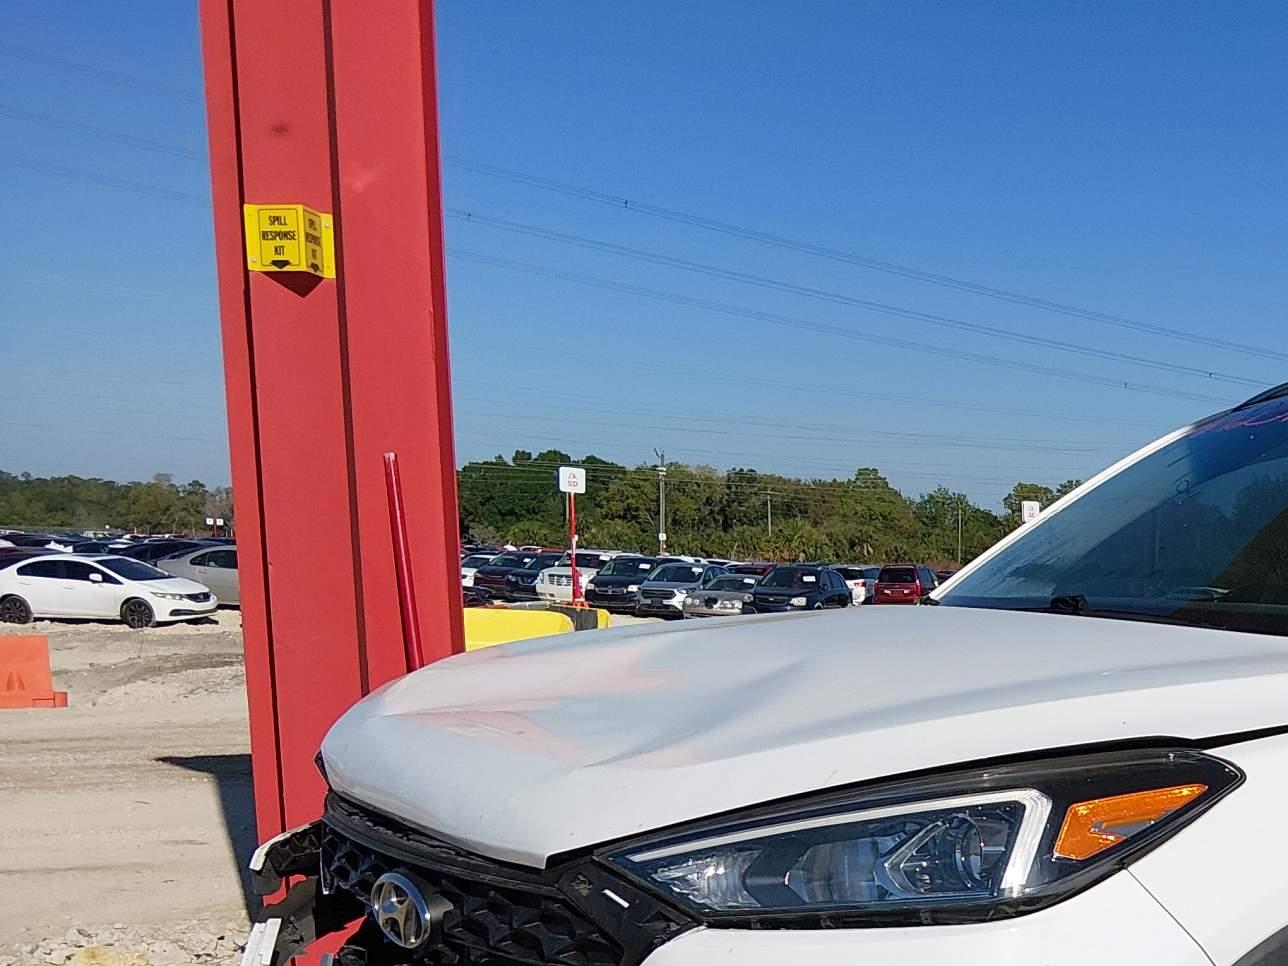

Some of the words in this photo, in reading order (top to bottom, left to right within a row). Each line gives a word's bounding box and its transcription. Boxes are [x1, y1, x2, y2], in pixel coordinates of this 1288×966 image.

[268, 215, 288, 226] SPILL
[261, 230, 297, 241] RESPONSE
[274, 245, 285, 256] KIT
